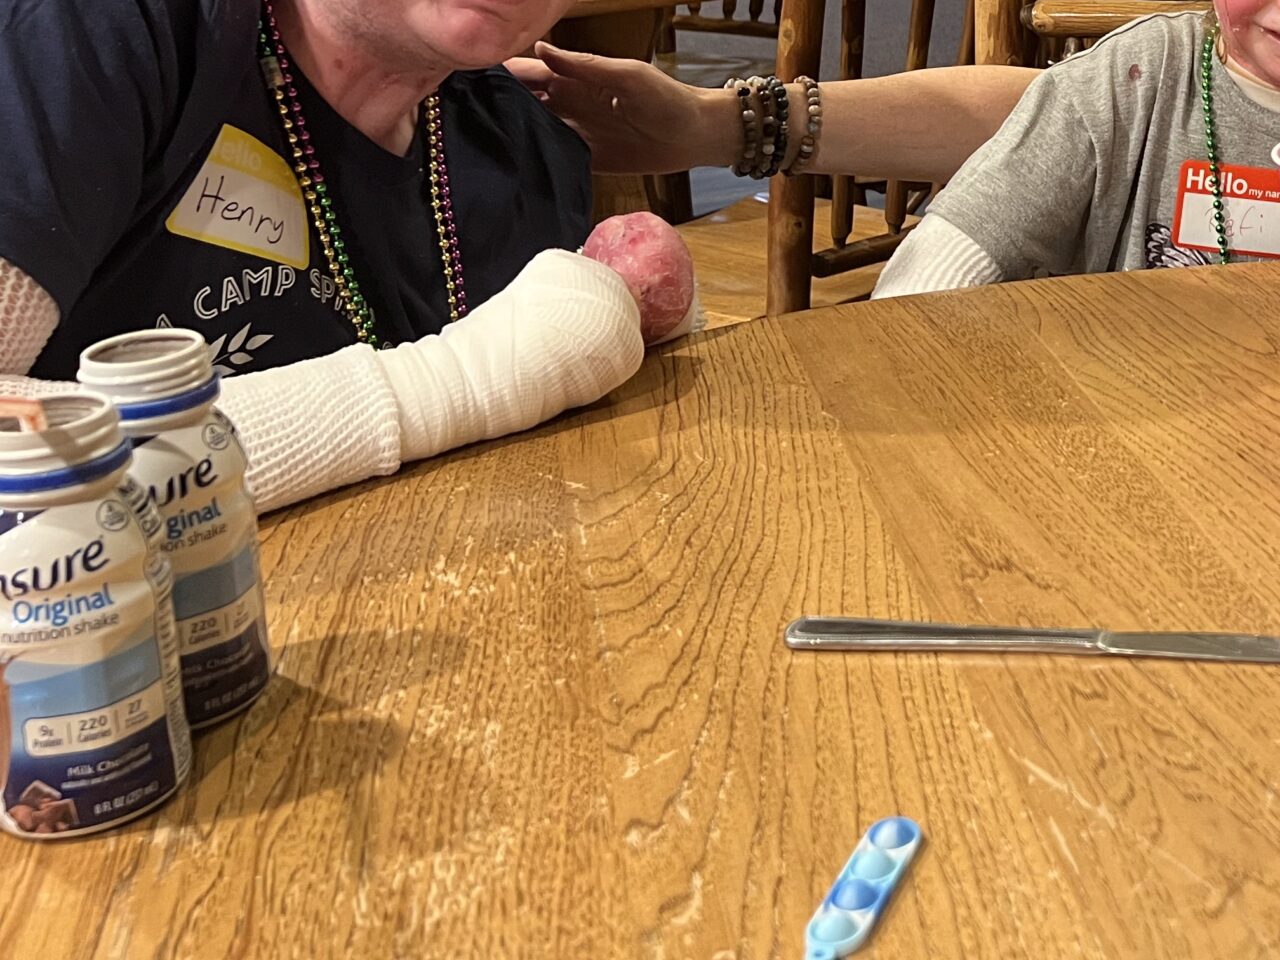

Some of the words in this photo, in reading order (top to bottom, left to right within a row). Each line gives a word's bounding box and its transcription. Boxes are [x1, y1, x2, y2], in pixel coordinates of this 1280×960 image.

[1186, 167, 1248, 195] Hello
[1248, 188, 1263, 199] my
[195, 175, 285, 244] Henry
[193, 266, 296, 320] CAMP
[13, 582, 114, 627] Original
[74, 612, 120, 635] shake
[79, 715, 108, 731] 220
